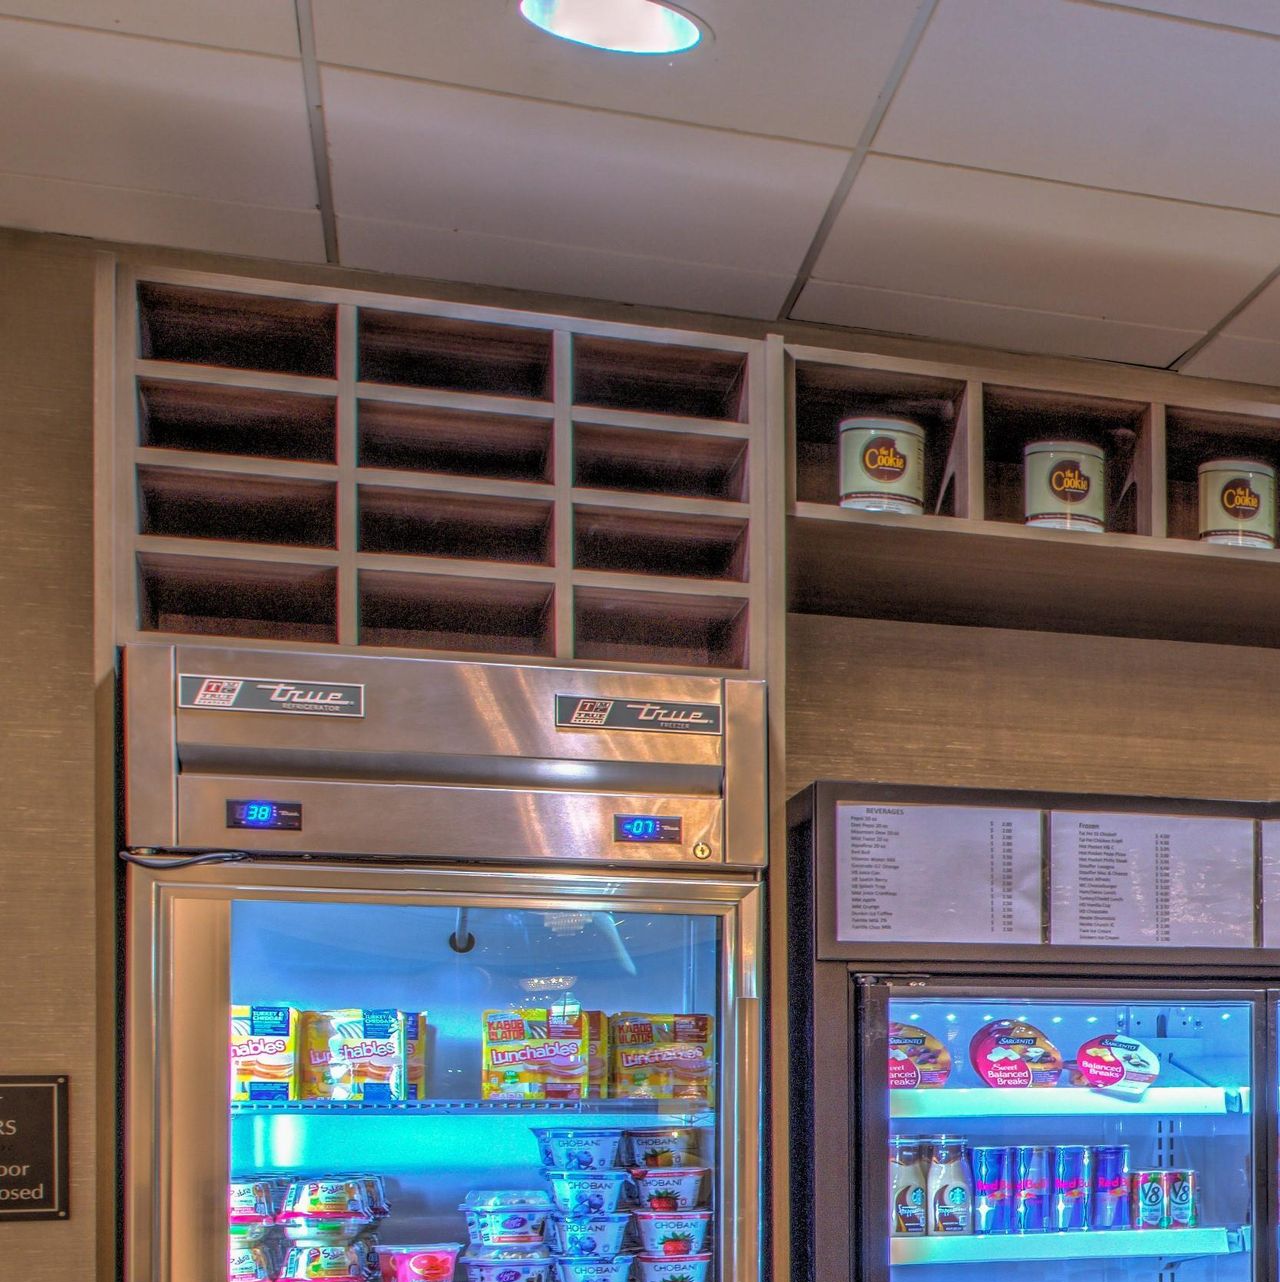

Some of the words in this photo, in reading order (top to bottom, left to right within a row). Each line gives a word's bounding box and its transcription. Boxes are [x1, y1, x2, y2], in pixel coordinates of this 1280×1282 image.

[865, 447, 904, 469] Cookie
[1052, 469, 1088, 491] Cookie
[1223, 489, 1258, 508] Cookie
[282, 702, 340, 712] REFRIGERATOR
[247, 805, 270, 821] 38
[866, 807, 904, 815] BEVERAGES
[491, 1042, 578, 1065] Lunchables
[1082, 1060, 1122, 1073] Balanced
[987, 1070, 1029, 1078] Balanced
[1089, 1068, 1120, 1078] Breaks
[559, 1139, 599, 1148] CHOBANI
[0, 1164, 30, 1177] oor
[568, 1181, 614, 1190] CHOBANI
[1099, 1178, 1120, 1188] Red
[0, 1183, 44, 1200] osed
[1141, 1182, 1160, 1202] V8
[1170, 1181, 1190, 1201] V8
[655, 1221, 699, 1230] CHOBANI
[574, 1265, 619, 1274] CHOBANI
[654, 1263, 697, 1272] CHOBANI
